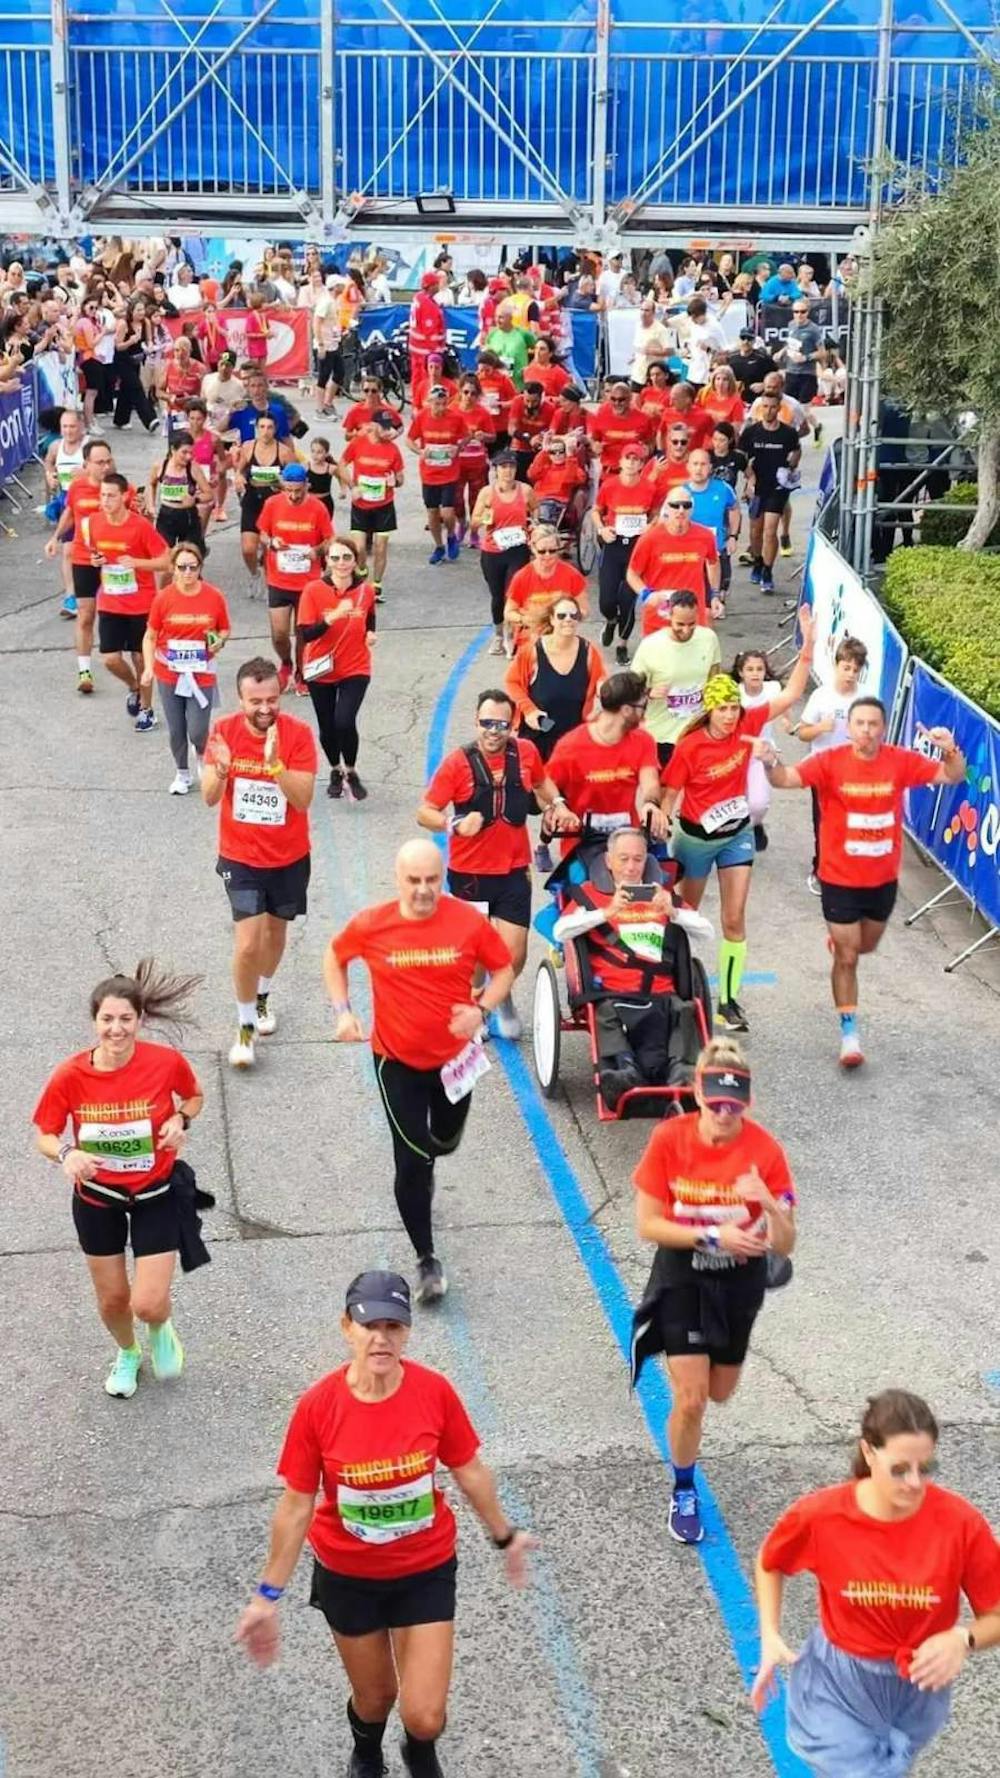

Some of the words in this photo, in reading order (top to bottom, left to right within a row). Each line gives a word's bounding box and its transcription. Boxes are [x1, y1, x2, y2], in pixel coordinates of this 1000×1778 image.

[241, 792, 279, 808] 44349
[80, 1101, 120, 1122] FINISH
[123, 1098, 151, 1120] LINE
[95, 1139, 142, 1154] 19623
[342, 1459, 394, 1485] FINISH
[398, 1450, 429, 1477] LINE
[358, 1498, 420, 1521] 19617
[846, 1580, 897, 1611] FINISH
[901, 1584, 935, 1612] LINE
